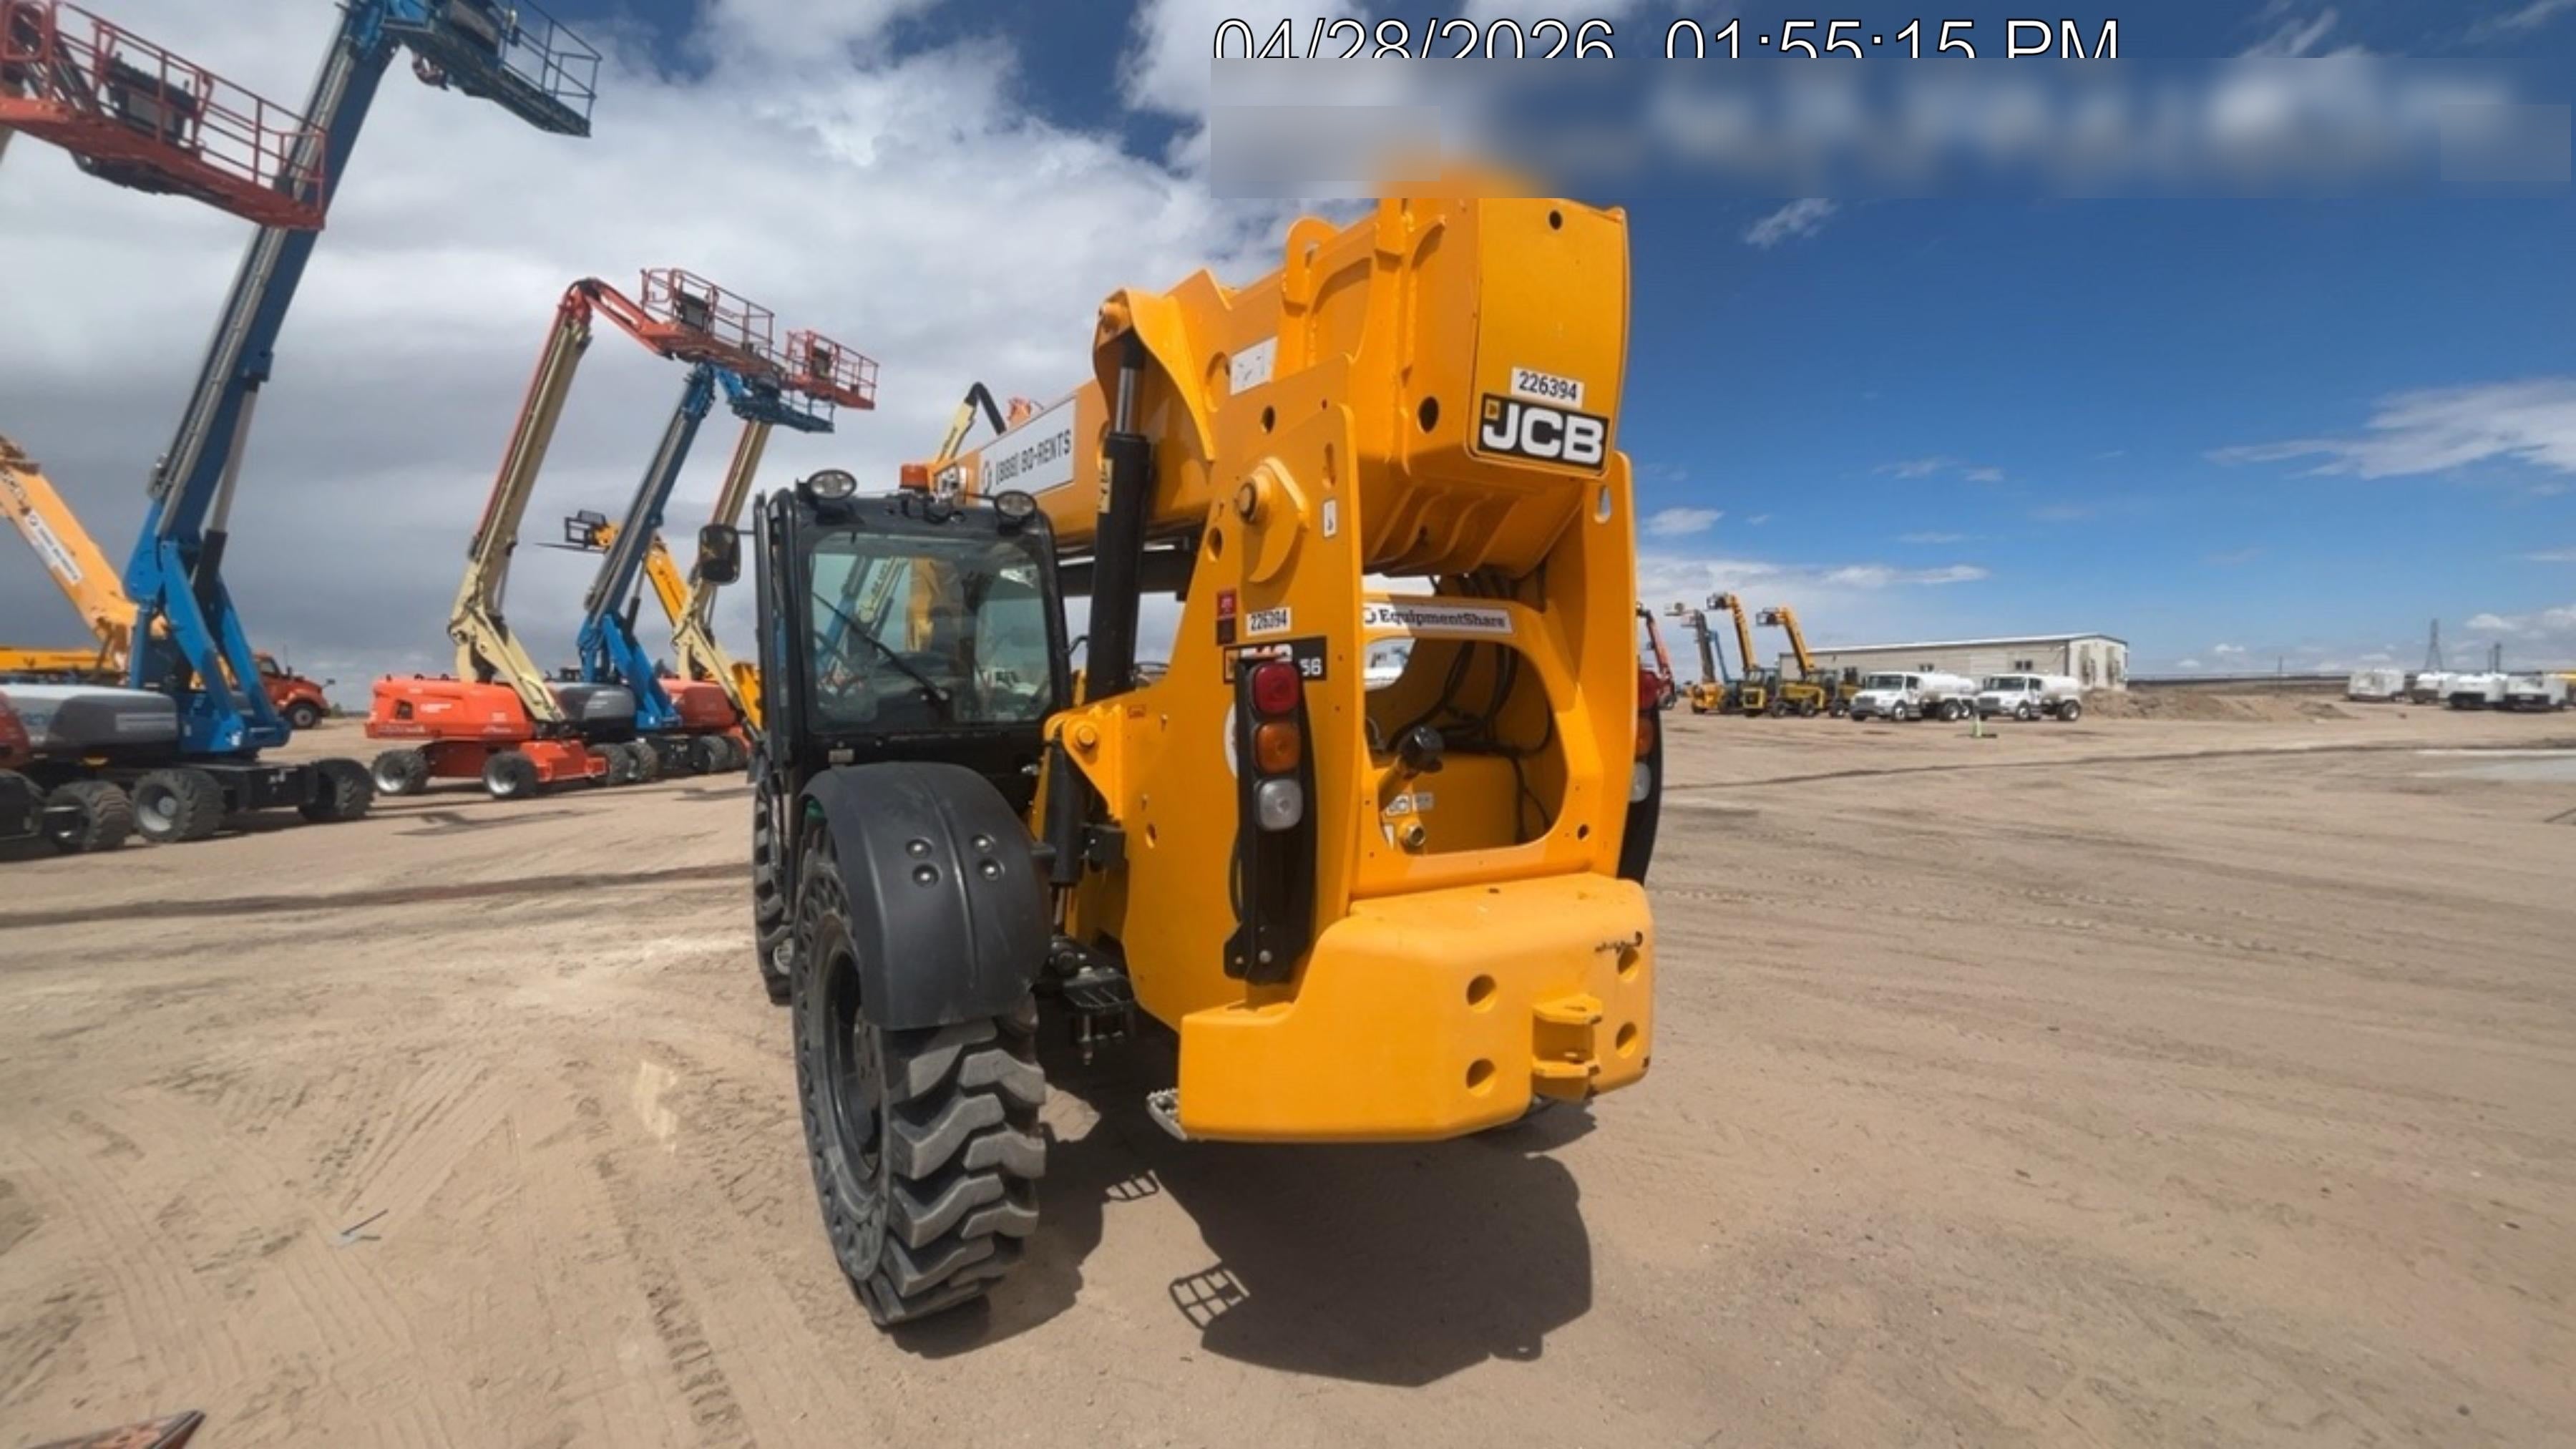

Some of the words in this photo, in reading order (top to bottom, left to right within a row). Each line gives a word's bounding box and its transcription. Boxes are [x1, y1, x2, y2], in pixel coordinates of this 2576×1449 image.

[1518, 370, 1578, 401] 226394
[1482, 401, 1604, 465] JCB
[1379, 608, 1506, 628] EquipmentShare
